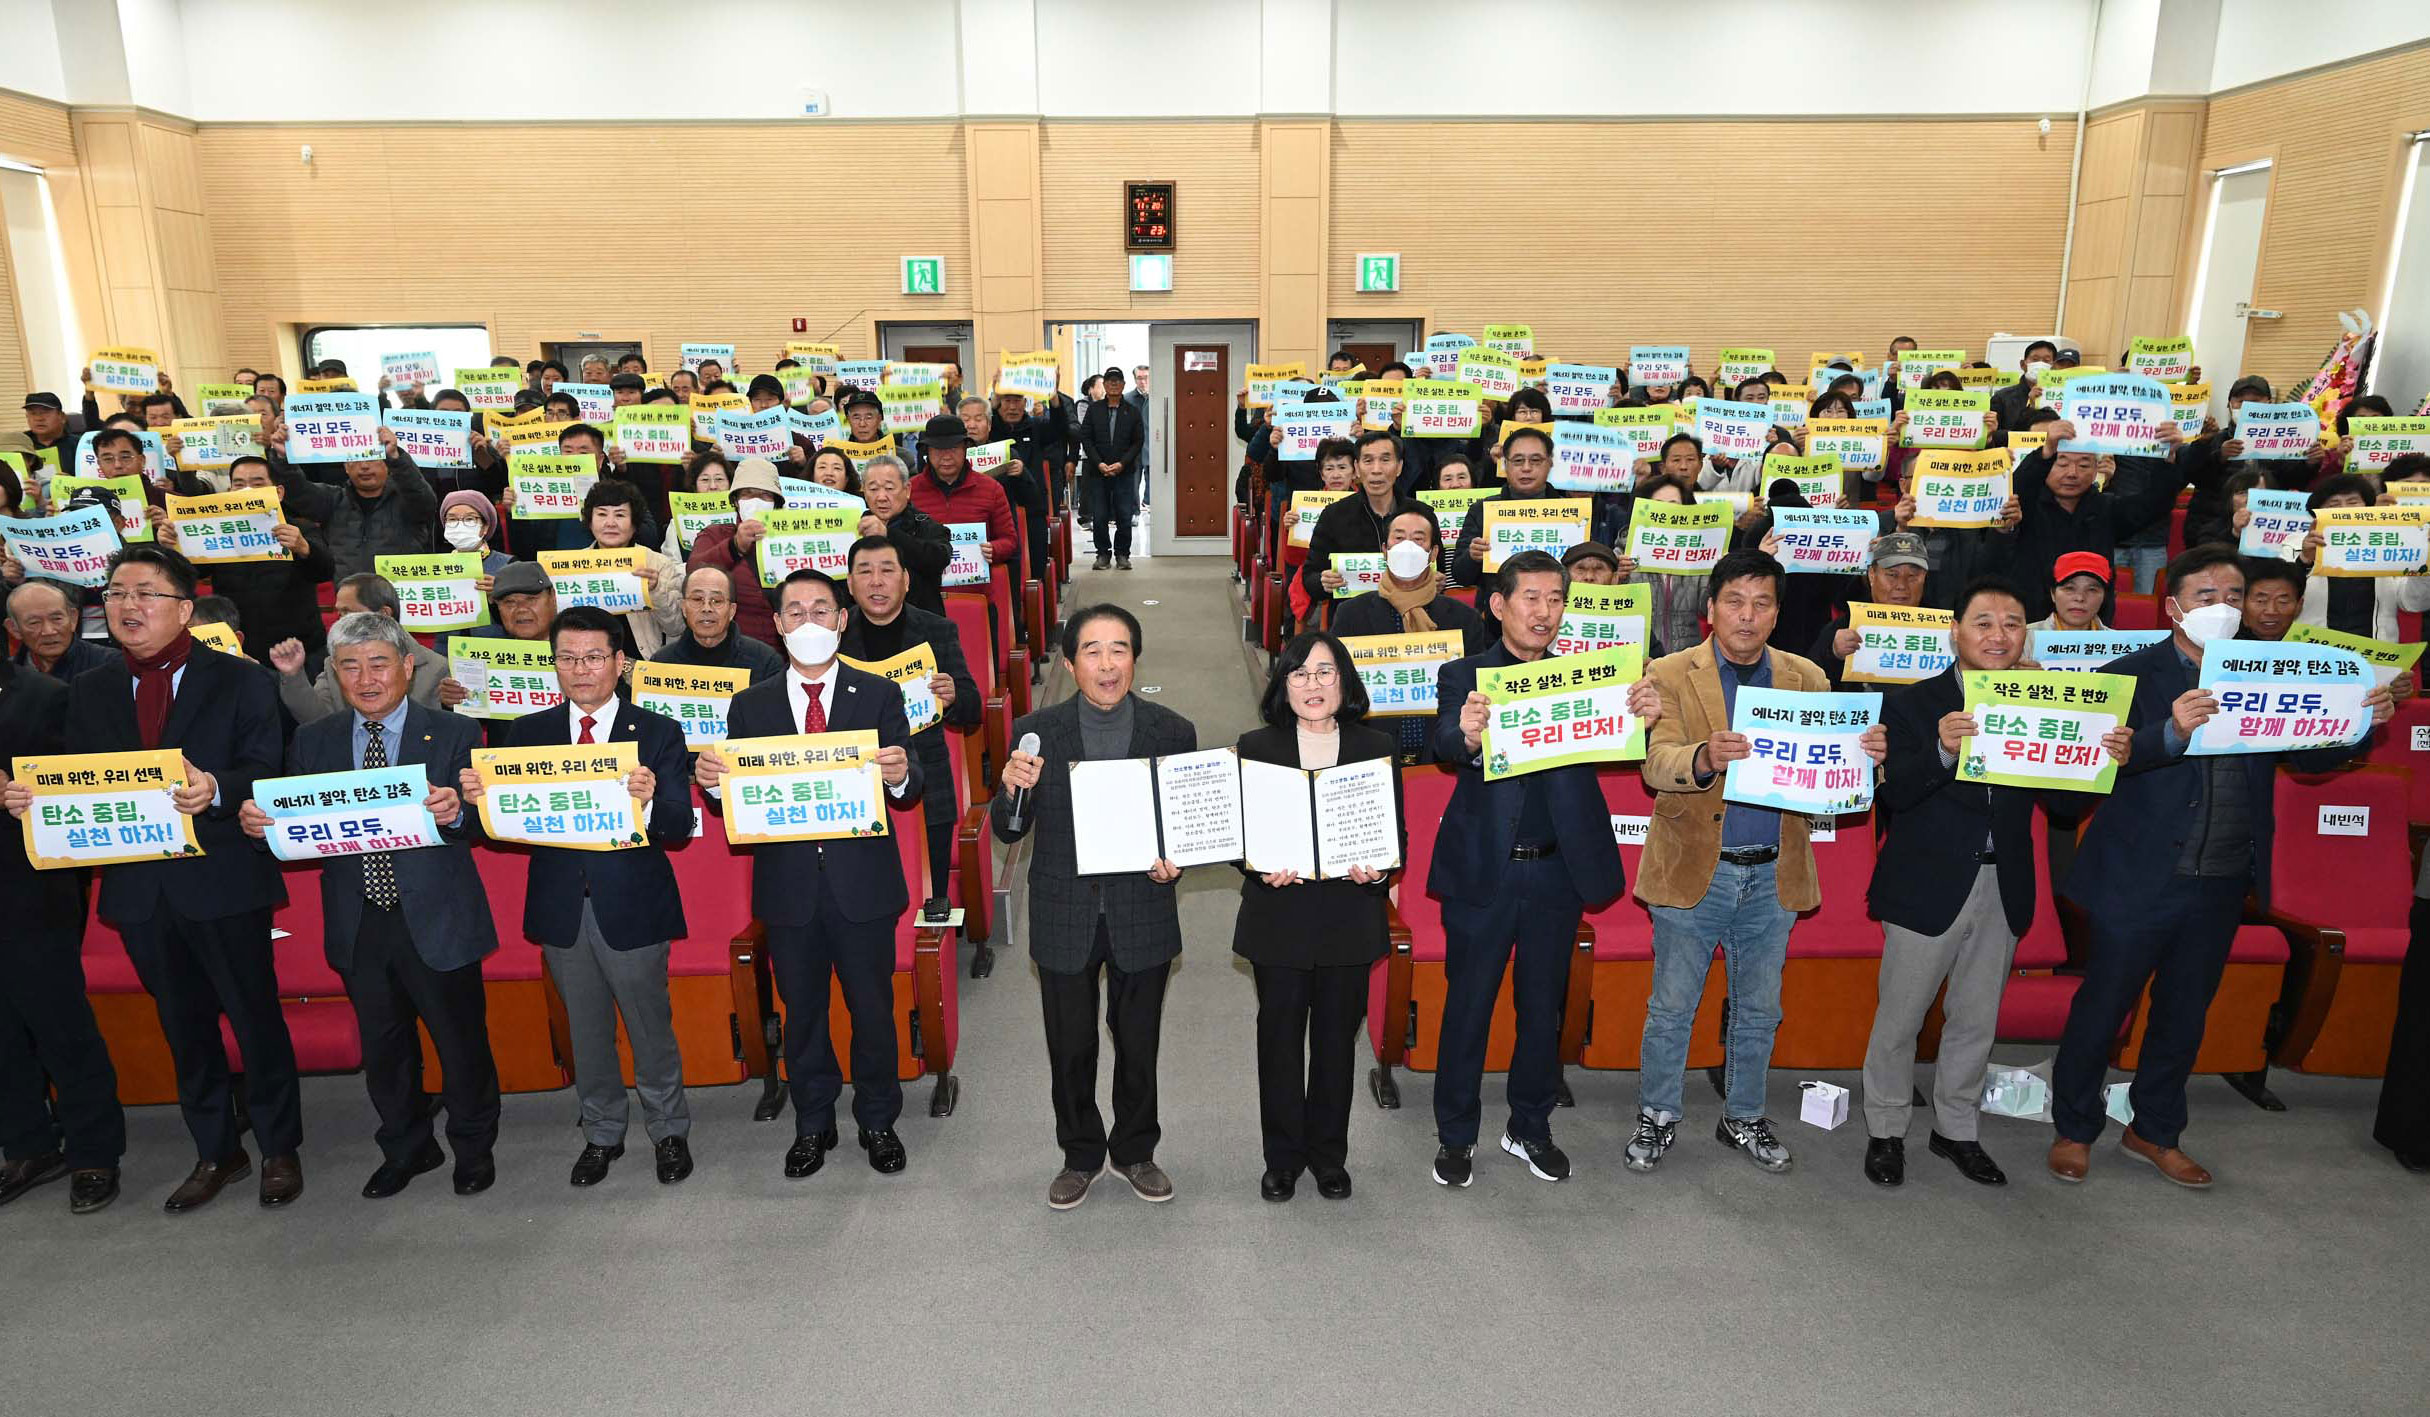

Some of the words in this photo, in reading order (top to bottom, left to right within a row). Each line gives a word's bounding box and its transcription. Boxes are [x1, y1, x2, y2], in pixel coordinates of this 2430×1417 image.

[1150, 226, 1163, 235] 23
[2136, 358, 2154, 366] 탄소
[2158, 358, 2178, 366] 중립,
[2142, 368, 2162, 376] 우리
[2165, 366, 2186, 374] 먼저!
[1416, 388, 1428, 396] 작은
[1431, 388, 1445, 396] 실천,
[1448, 388, 1454, 396] 큰
[290, 404, 313, 412] 에너지
[315, 403, 333, 412] 절약,
[336, 402, 352, 411] 탄소
[354, 402, 370, 410] 감축
[1413, 404, 1432, 414] 탄소
[1438, 404, 1461, 415] 중립,
[1919, 398, 1932, 406] 작은
[1953, 399, 1960, 407] 큰
[1422, 416, 1442, 426] 우리
[1448, 417, 1472, 427] 먼저!
[1914, 415, 1934, 425] 탄소
[1940, 416, 1965, 426] 중립,
[295, 423, 321, 435] 우리
[326, 422, 356, 434] 모두,
[623, 429, 642, 440] 탄소
[648, 430, 672, 441] 중립,
[1923, 428, 1945, 438] 우리
[1950, 428, 1977, 438] 먼저!
[2246, 428, 2270, 437] 우리
[2274, 427, 2300, 437] 모두,
[310, 436, 336, 448] 함께
[341, 434, 372, 447] 하자!
[634, 442, 654, 452] 우리
[659, 442, 684, 452] 먼저!
[2255, 439, 2278, 448] 함께
[2282, 438, 2310, 448] 하자!
[1930, 462, 1949, 470] 미래
[1952, 463, 1973, 473] 위한,
[1976, 462, 1990, 472] 우리
[1992, 459, 2003, 470] 선택
[1926, 483, 1954, 496] 탄소
[1962, 483, 1992, 497] 중립,
[198, 505, 222, 513] 위한,
[224, 503, 242, 512] 우리
[246, 500, 265, 510] 선택
[1938, 499, 1968, 512] 실천
[1974, 497, 2003, 512] 하자!
[1650, 512, 1666, 523] 작은
[1670, 512, 1688, 525] 실천,
[1692, 515, 1700, 525] 큰
[1703, 514, 1719, 524] 변화
[1812, 515, 1831, 524] 절약,
[1834, 515, 1850, 524] 탄소
[1852, 516, 1868, 524] 감축
[2354, 512, 2376, 521] 위한,
[2380, 512, 2398, 520] 우리
[2401, 512, 2420, 522] 선택
[182, 524, 215, 536] 탄소
[220, 520, 256, 534] 중립,
[204, 536, 235, 550] 실천
[1642, 532, 1668, 546] 탄소
[1674, 534, 1704, 548] 중립,
[1784, 534, 1812, 546] 우리
[1816, 536, 1848, 549] 모두,
[2331, 532, 2361, 545] 탄소
[2369, 532, 2404, 546] 중립,
[1652, 548, 1680, 561] 우리
[1686, 548, 1716, 562] 먼저!
[1794, 548, 1822, 560] 함께
[1827, 550, 1861, 563] 하자!
[2345, 548, 2376, 562] 실천
[2384, 548, 2420, 562] 하자!
[2223, 660, 2268, 672] 에너지
[2272, 660, 2301, 675] 절약,
[2308, 660, 2332, 675] 탄소
[2336, 661, 2359, 676] 감축
[1506, 678, 1531, 694] 작은
[1537, 674, 1566, 690] 실천,
[1571, 670, 1584, 684] 큰
[1589, 665, 1616, 681] 변화
[1994, 683, 2021, 698] 작은
[2027, 685, 2057, 701] 실천,
[2063, 687, 2076, 702] 큰
[2082, 689, 2108, 704] 변화
[2220, 692, 2268, 712] 우리
[2276, 694, 2328, 716] 모두,
[1500, 708, 1541, 729] 탄소
[1551, 698, 1600, 721] 중립,
[1752, 708, 1794, 722] 에너지
[1800, 710, 1826, 726] 절약,
[1830, 711, 1846, 725] 탄소
[1851, 710, 1869, 725] 감축
[1522, 724, 1562, 747] 우리
[1573, 716, 1623, 740] 먼저!
[1985, 714, 2027, 736] 탄소
[2038, 718, 2083, 743] 중립,
[2239, 716, 2286, 736] 함께
[2293, 718, 2350, 736] 하자!
[738, 756, 764, 767] 미래
[769, 752, 799, 766] 위한,
[804, 750, 828, 764] 우리
[833, 746, 859, 762] 선택
[1753, 738, 1797, 762] 우리
[1806, 744, 1846, 766] 모두,
[2003, 740, 2048, 763] 우리
[2055, 745, 2100, 766] 먼저!
[495, 764, 522, 776] 미래
[526, 761, 556, 775] 위한,
[562, 760, 586, 774] 우리
[591, 758, 617, 772] 선택
[36, 774, 64, 786] 미래
[68, 770, 99, 785] 위한,
[104, 770, 129, 784] 우리
[134, 768, 163, 782] 선택
[1773, 765, 1817, 789] 함께
[1826, 768, 1861, 789] 하자!
[274, 794, 315, 808] 에너지
[318, 790, 350, 806] 절약,
[354, 787, 381, 802] 탄소
[384, 782, 411, 799] 감축
[742, 785, 784, 805] 탄소
[792, 780, 840, 802] 중립,
[499, 794, 541, 813] 탄소
[550, 790, 600, 811] 중립,
[42, 805, 84, 826] 탄소
[92, 801, 145, 823] 중립,
[766, 805, 808, 825] 실천
[815, 800, 864, 821] 하자!
[2324, 814, 2364, 826] 내빈석
[288, 823, 332, 842] 우리
[340, 818, 392, 838] 모두,
[523, 815, 565, 833] 실천
[573, 812, 623, 832] 하자!
[67, 827, 112, 848] 실천
[118, 823, 173, 844] 하자!
[316, 841, 362, 854] 함께
[368, 835, 421, 849] 하자!
